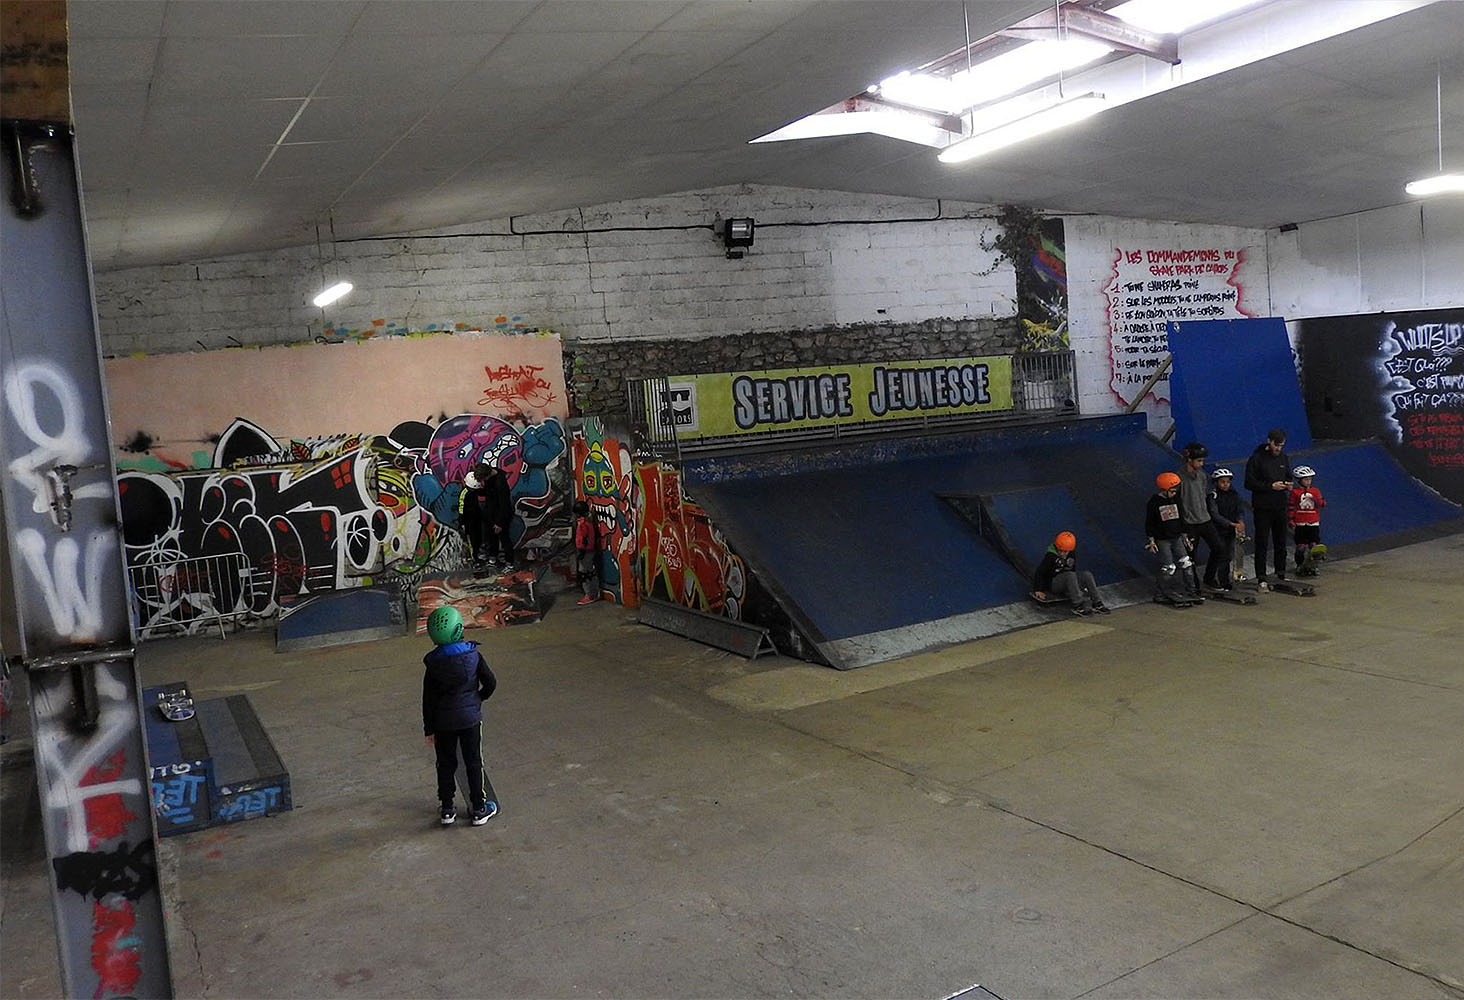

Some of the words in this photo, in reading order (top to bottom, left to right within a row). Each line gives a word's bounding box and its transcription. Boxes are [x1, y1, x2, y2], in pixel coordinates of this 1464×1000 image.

[1126, 250, 1142, 264] LES
[733, 375, 853, 430] SERVICE
[869, 363, 991, 417] JEUNESSE
